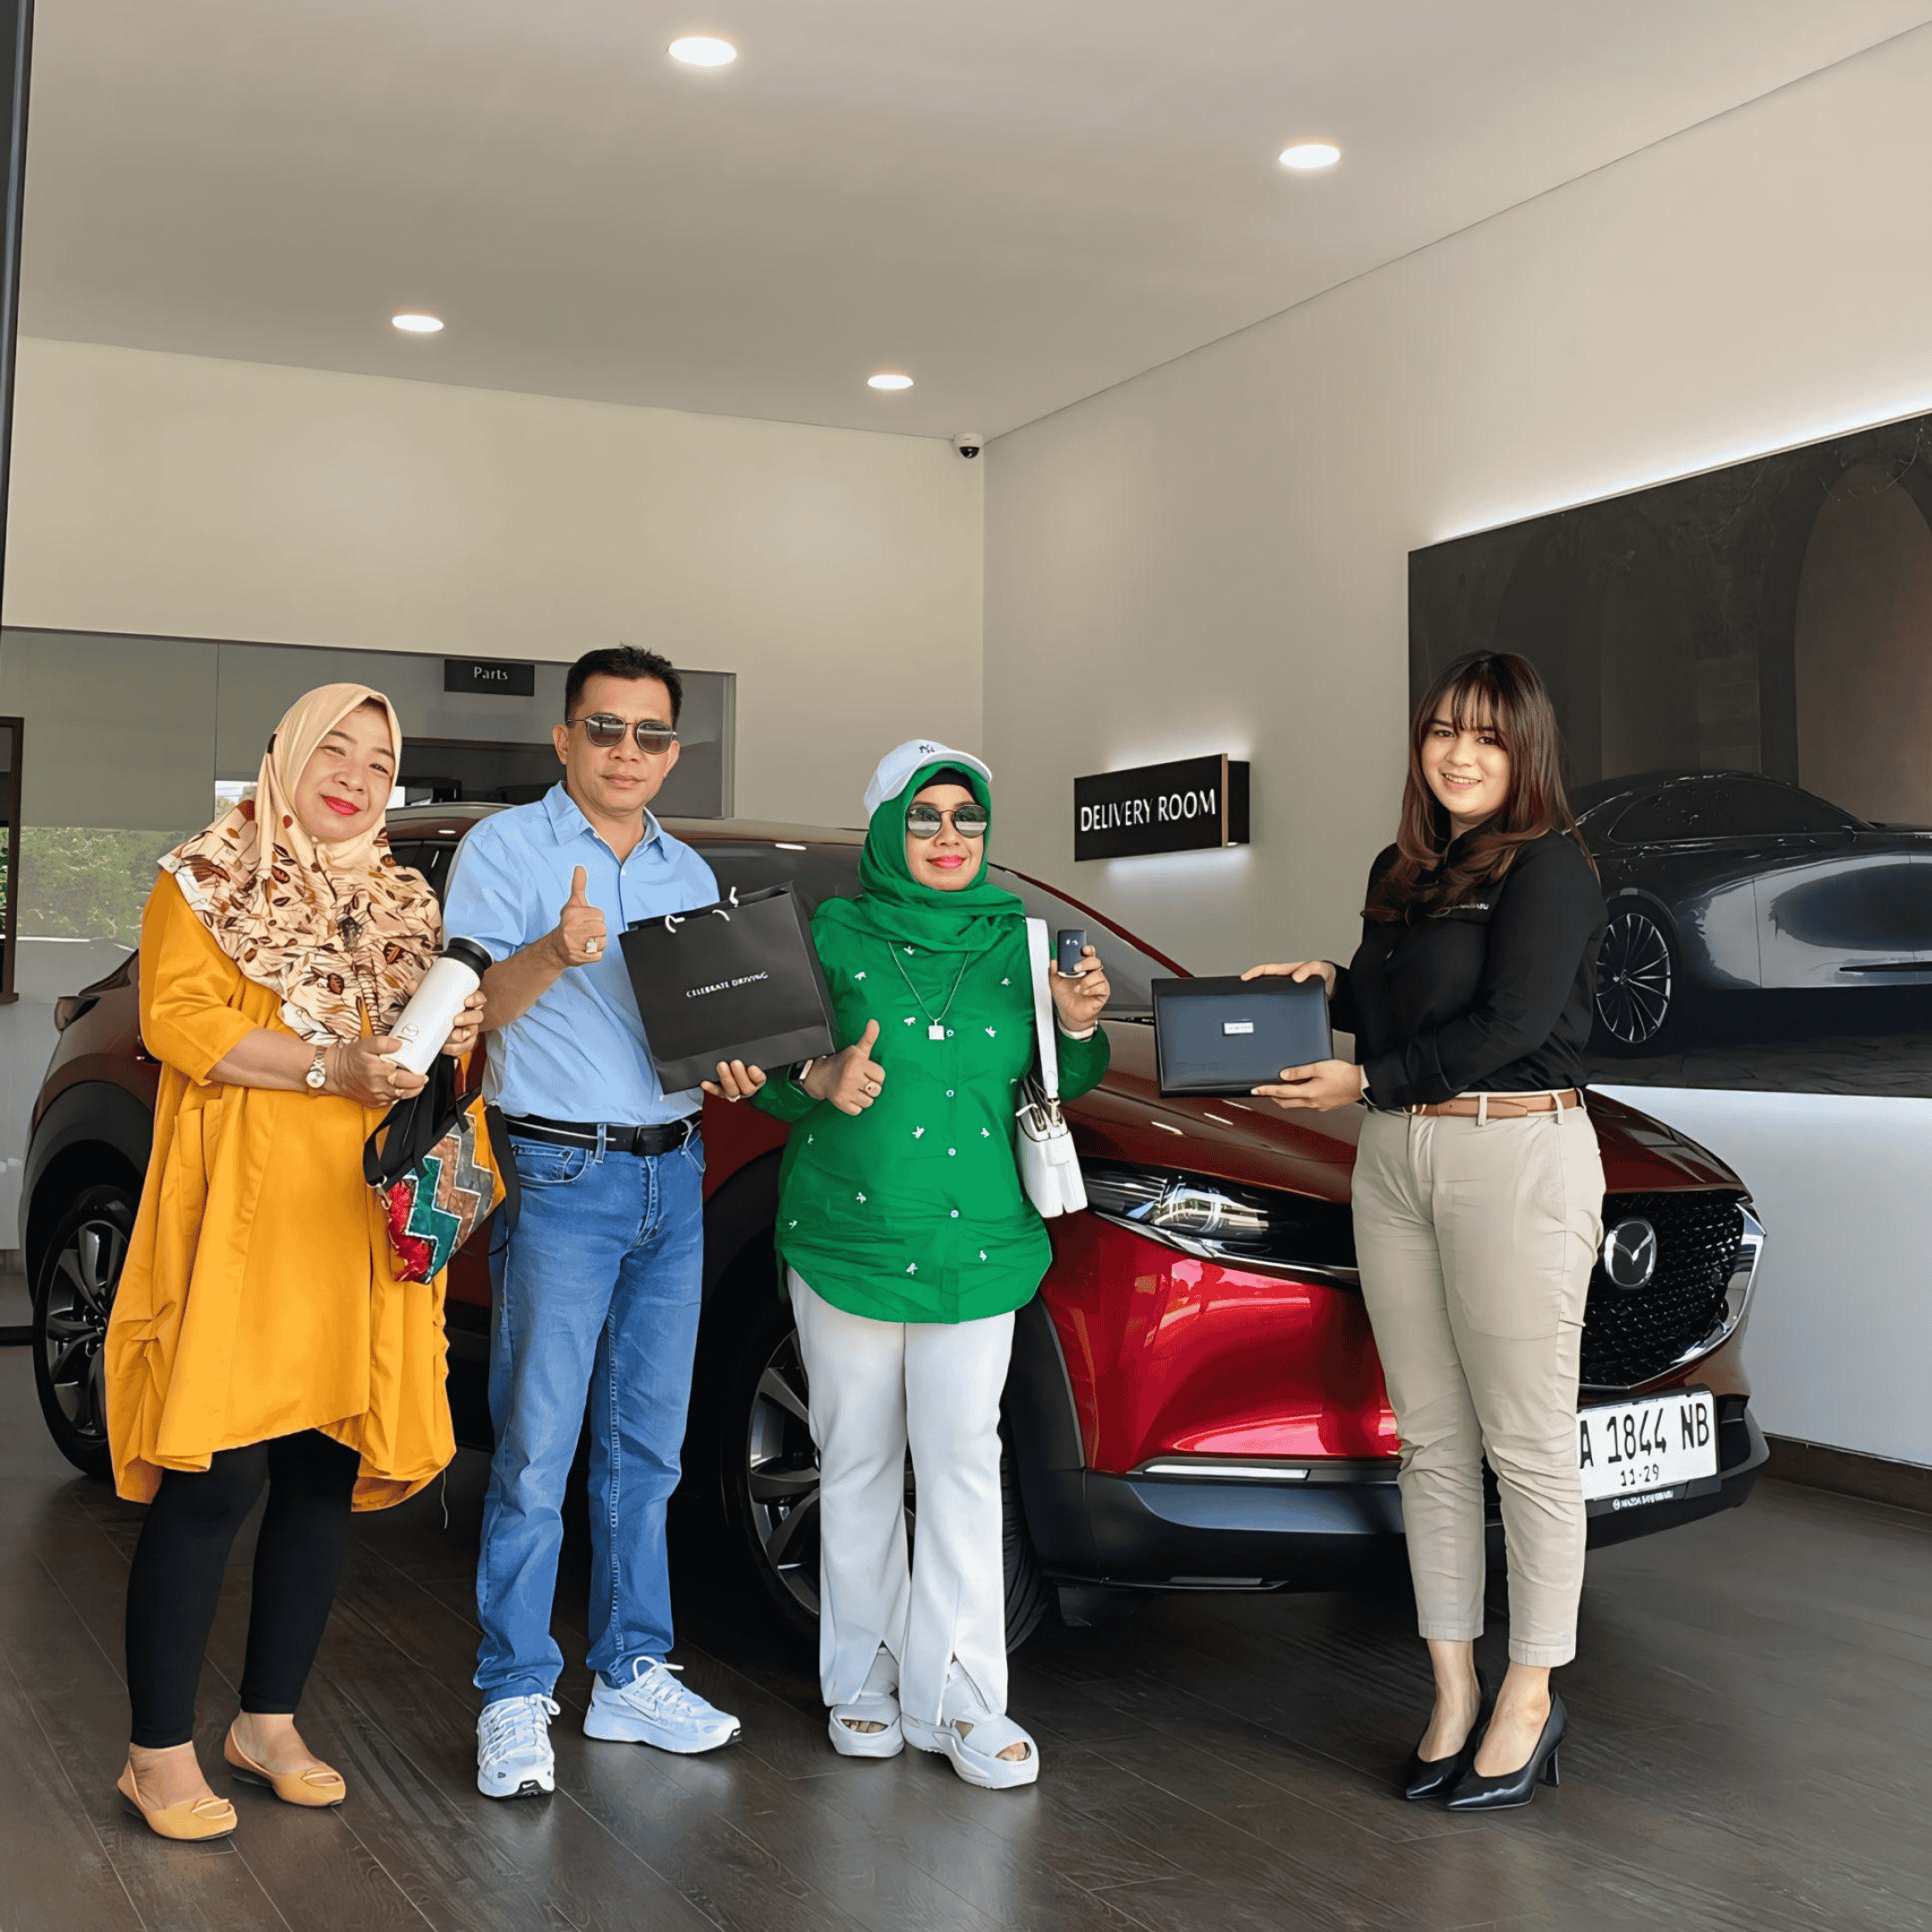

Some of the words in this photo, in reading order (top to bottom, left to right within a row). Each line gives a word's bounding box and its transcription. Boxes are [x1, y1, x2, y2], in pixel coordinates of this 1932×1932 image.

[473, 666, 508, 680] Parts
[1080, 798, 1154, 832] DELIVERY
[1157, 788, 1216, 822] ROOM
[1606, 1407, 1667, 1463] 1844
[1680, 1402, 1709, 1450] NB
